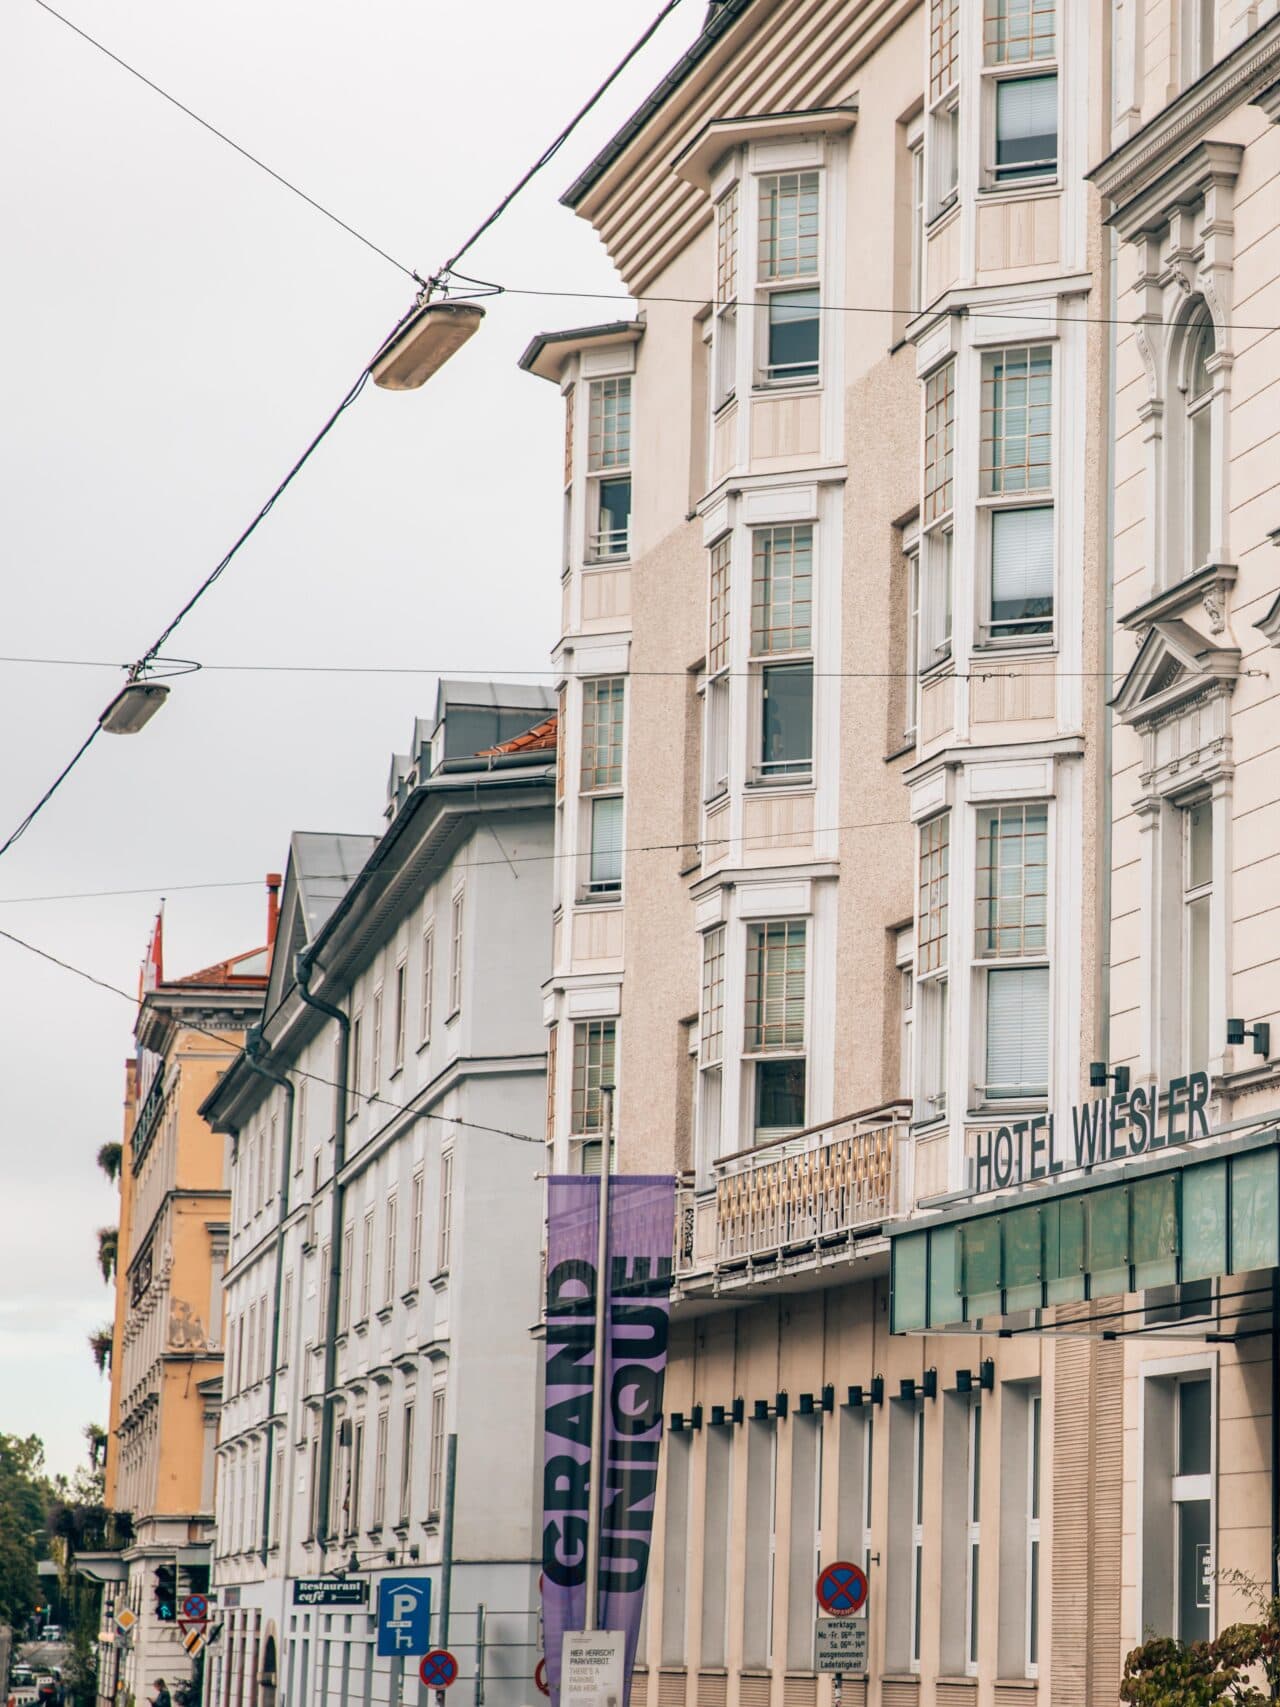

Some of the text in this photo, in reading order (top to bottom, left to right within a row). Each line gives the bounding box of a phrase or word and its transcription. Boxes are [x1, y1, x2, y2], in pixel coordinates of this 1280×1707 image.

[976, 1071, 1209, 1193] HOTEL WIESLER
[542, 1259, 597, 1587] GRAND
[599, 1257, 672, 1593] UNIQUE
[300, 1582, 360, 1591] Restaurant
[299, 1591, 324, 1604] café
[393, 1594, 417, 1620] P
[828, 1621, 856, 1630] werktags
[819, 1652, 864, 1660] ausgenommen
